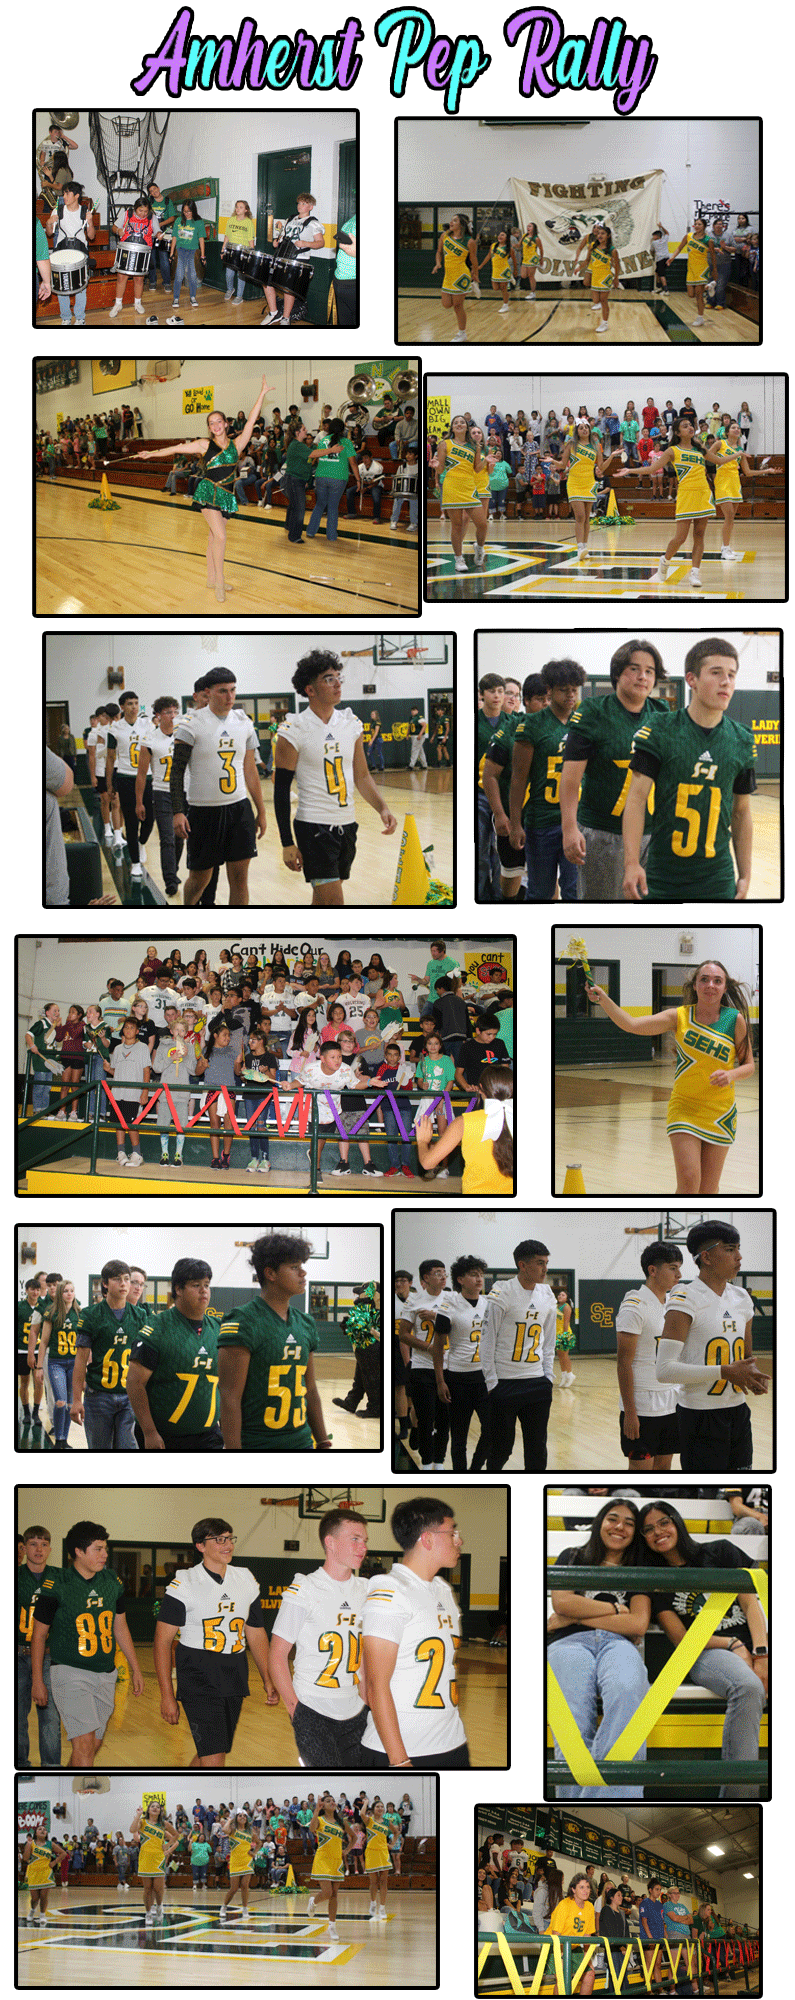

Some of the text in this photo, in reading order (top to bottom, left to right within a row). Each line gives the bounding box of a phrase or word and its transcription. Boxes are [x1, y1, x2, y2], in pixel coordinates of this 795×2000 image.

[528, 176, 646, 199] FIGHTING
[428, 415, 446, 423] BIG
[450, 447, 475, 463] SEHS
[752, 719, 780, 731] LADY
[217, 749, 237, 795] 3
[323, 755, 349, 808] 4
[671, 783, 723, 859] 51
[270, 943, 299, 956] Hide
[300, 942, 325, 956] Our
[349, 1005, 365, 1018] 25
[683, 1029, 732, 1063] SEHS
[511, 1321, 543, 1363] 12
[168, 1372, 220, 1428] 77
[263, 1364, 307, 1430] 55
[75, 1610, 114, 1658] 88
[313, 1630, 363, 1689] 24
